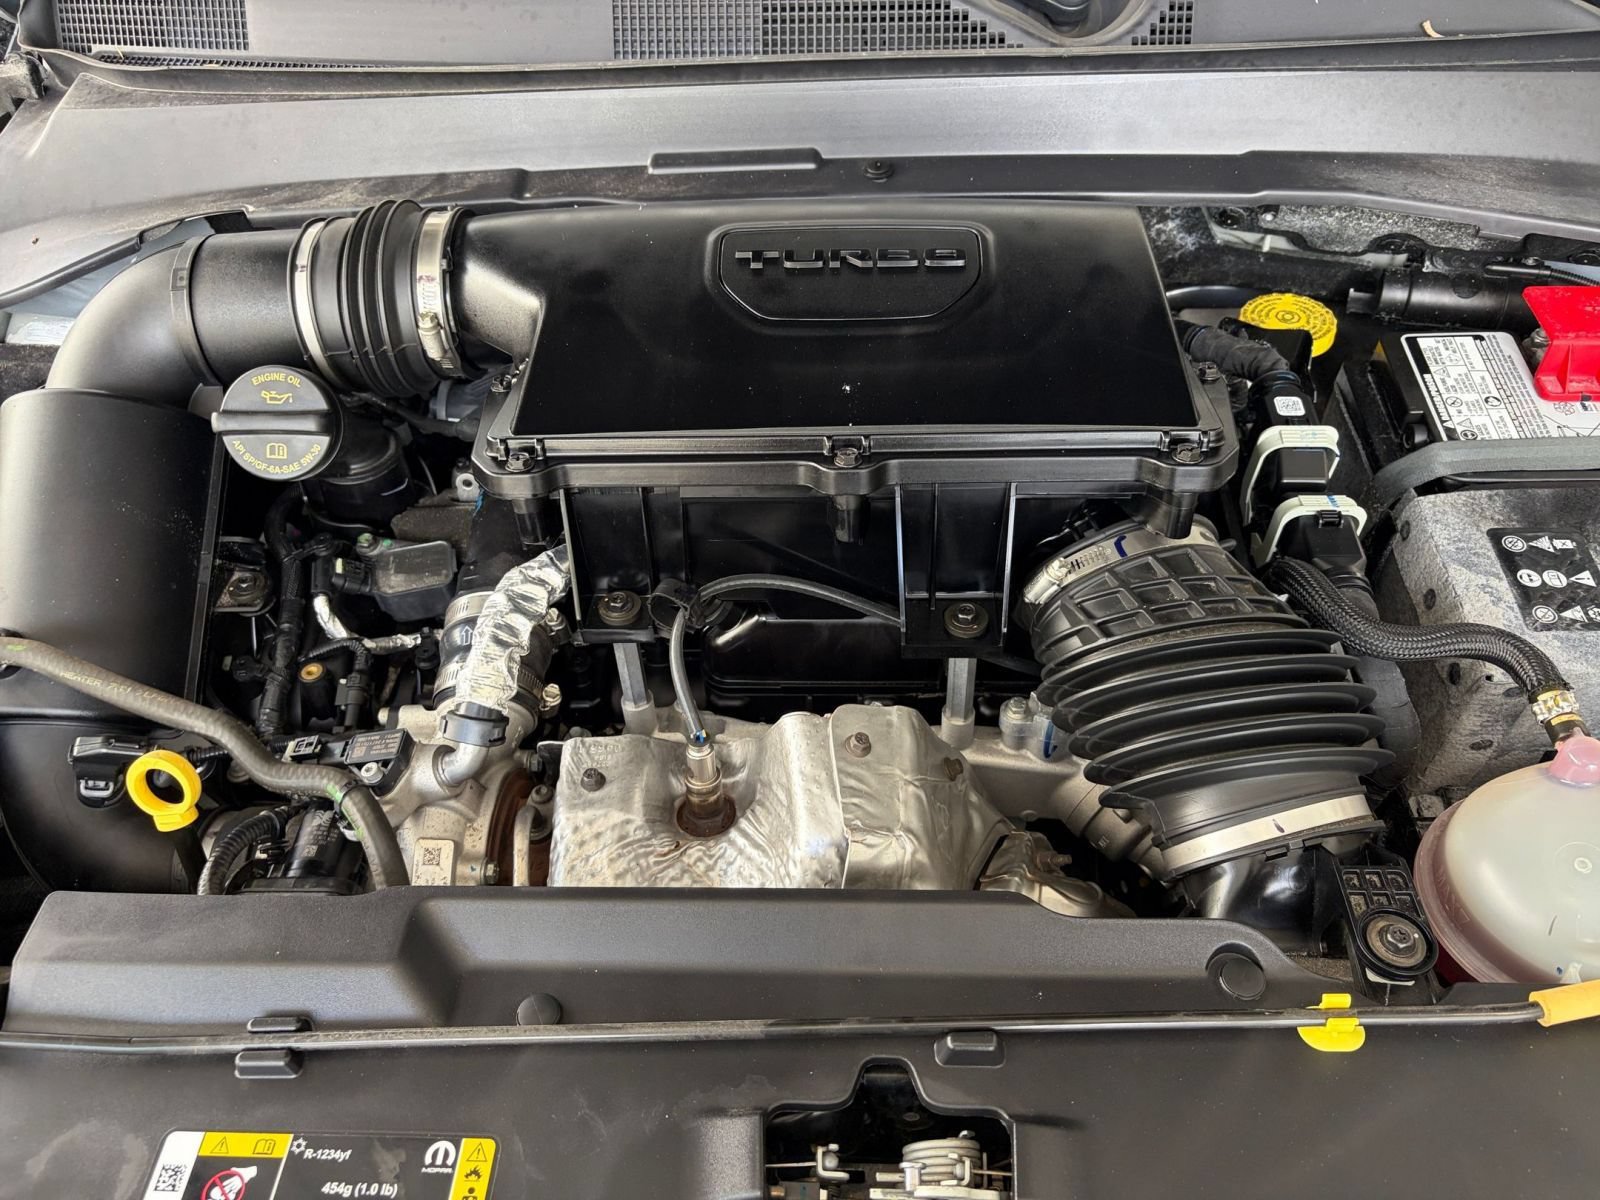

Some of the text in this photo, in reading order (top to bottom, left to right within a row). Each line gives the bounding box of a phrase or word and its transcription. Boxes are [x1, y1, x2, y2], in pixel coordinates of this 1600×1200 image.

[734, 248, 967, 269] TURBO
[251, 372, 302, 388] ENGINE OIL
[232, 440, 244, 455] API
[301, 443, 321, 466] 5W-30
[303, 1148, 353, 1163] R-1234yf
[321, 1181, 398, 1199] 454g (1.0 lb)
